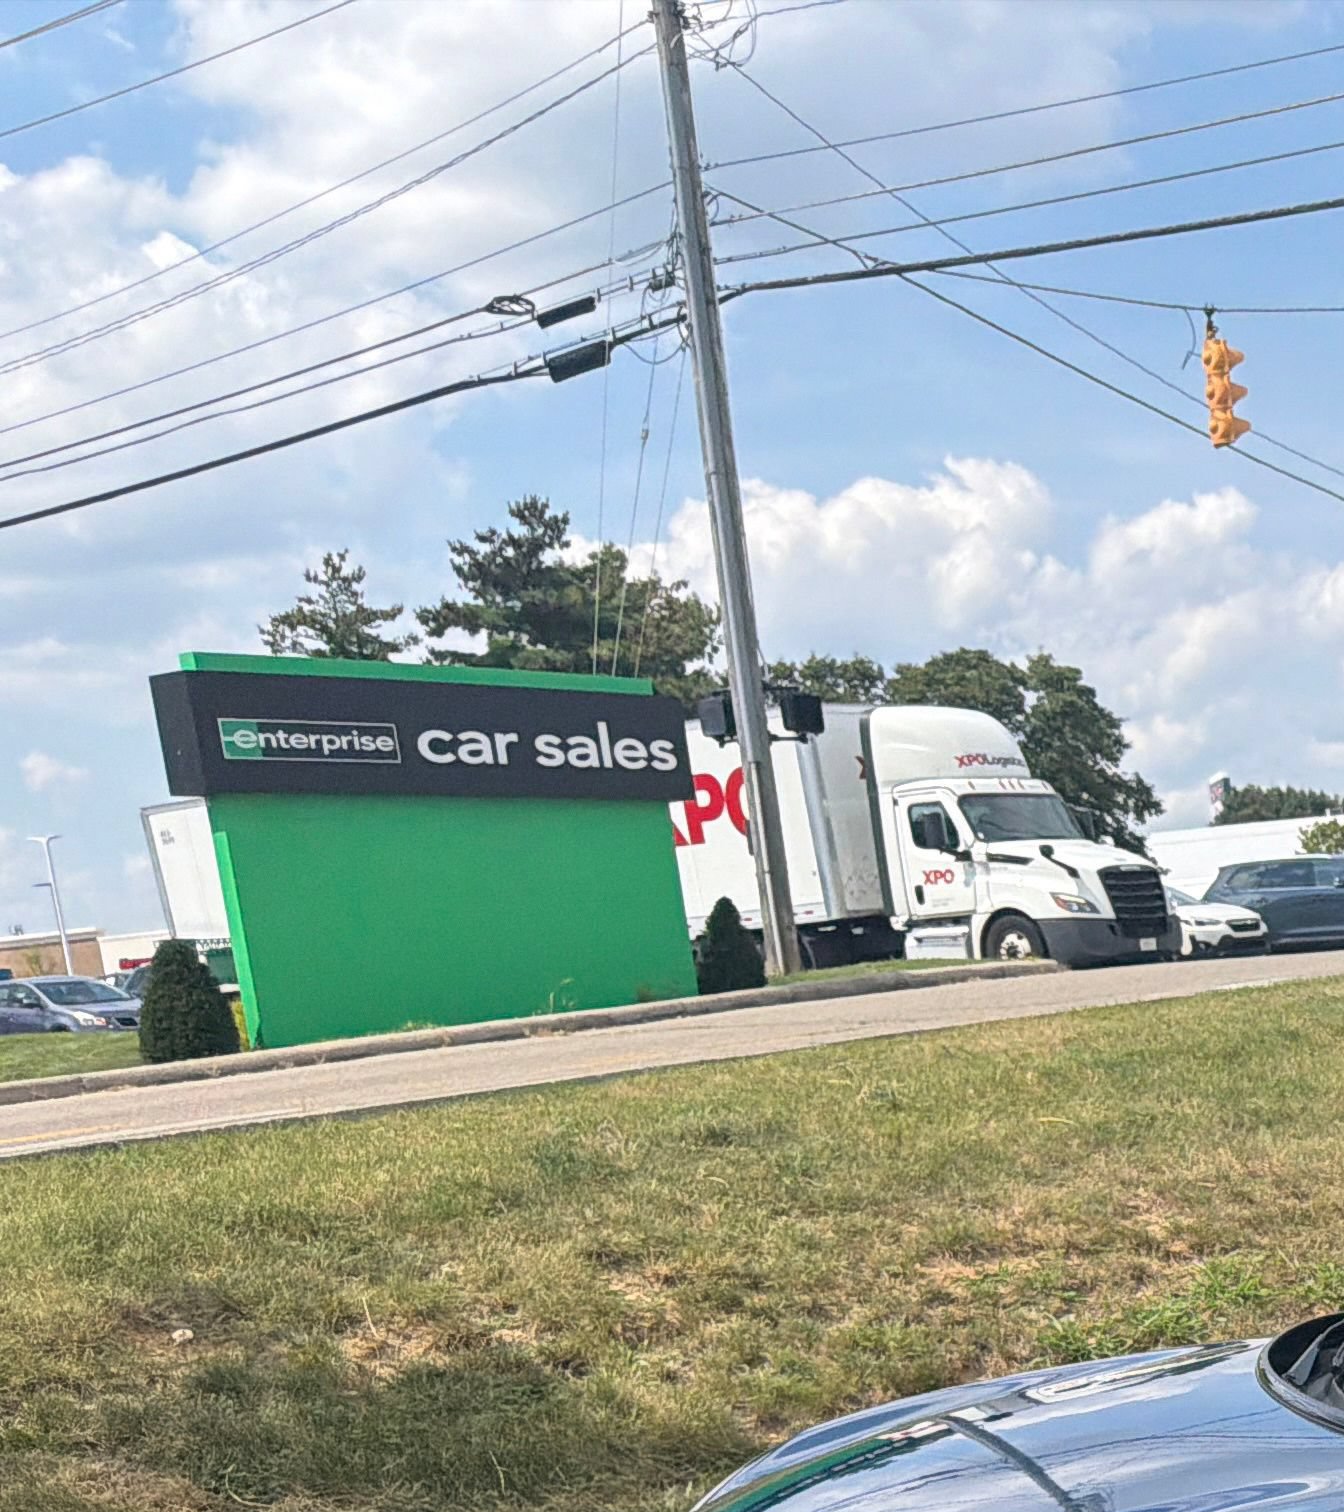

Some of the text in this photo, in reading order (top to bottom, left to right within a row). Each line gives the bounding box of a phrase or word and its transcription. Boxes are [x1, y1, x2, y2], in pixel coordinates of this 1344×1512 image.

[233, 721, 678, 771] enterprise car sales
[922, 869, 955, 885] XPO
